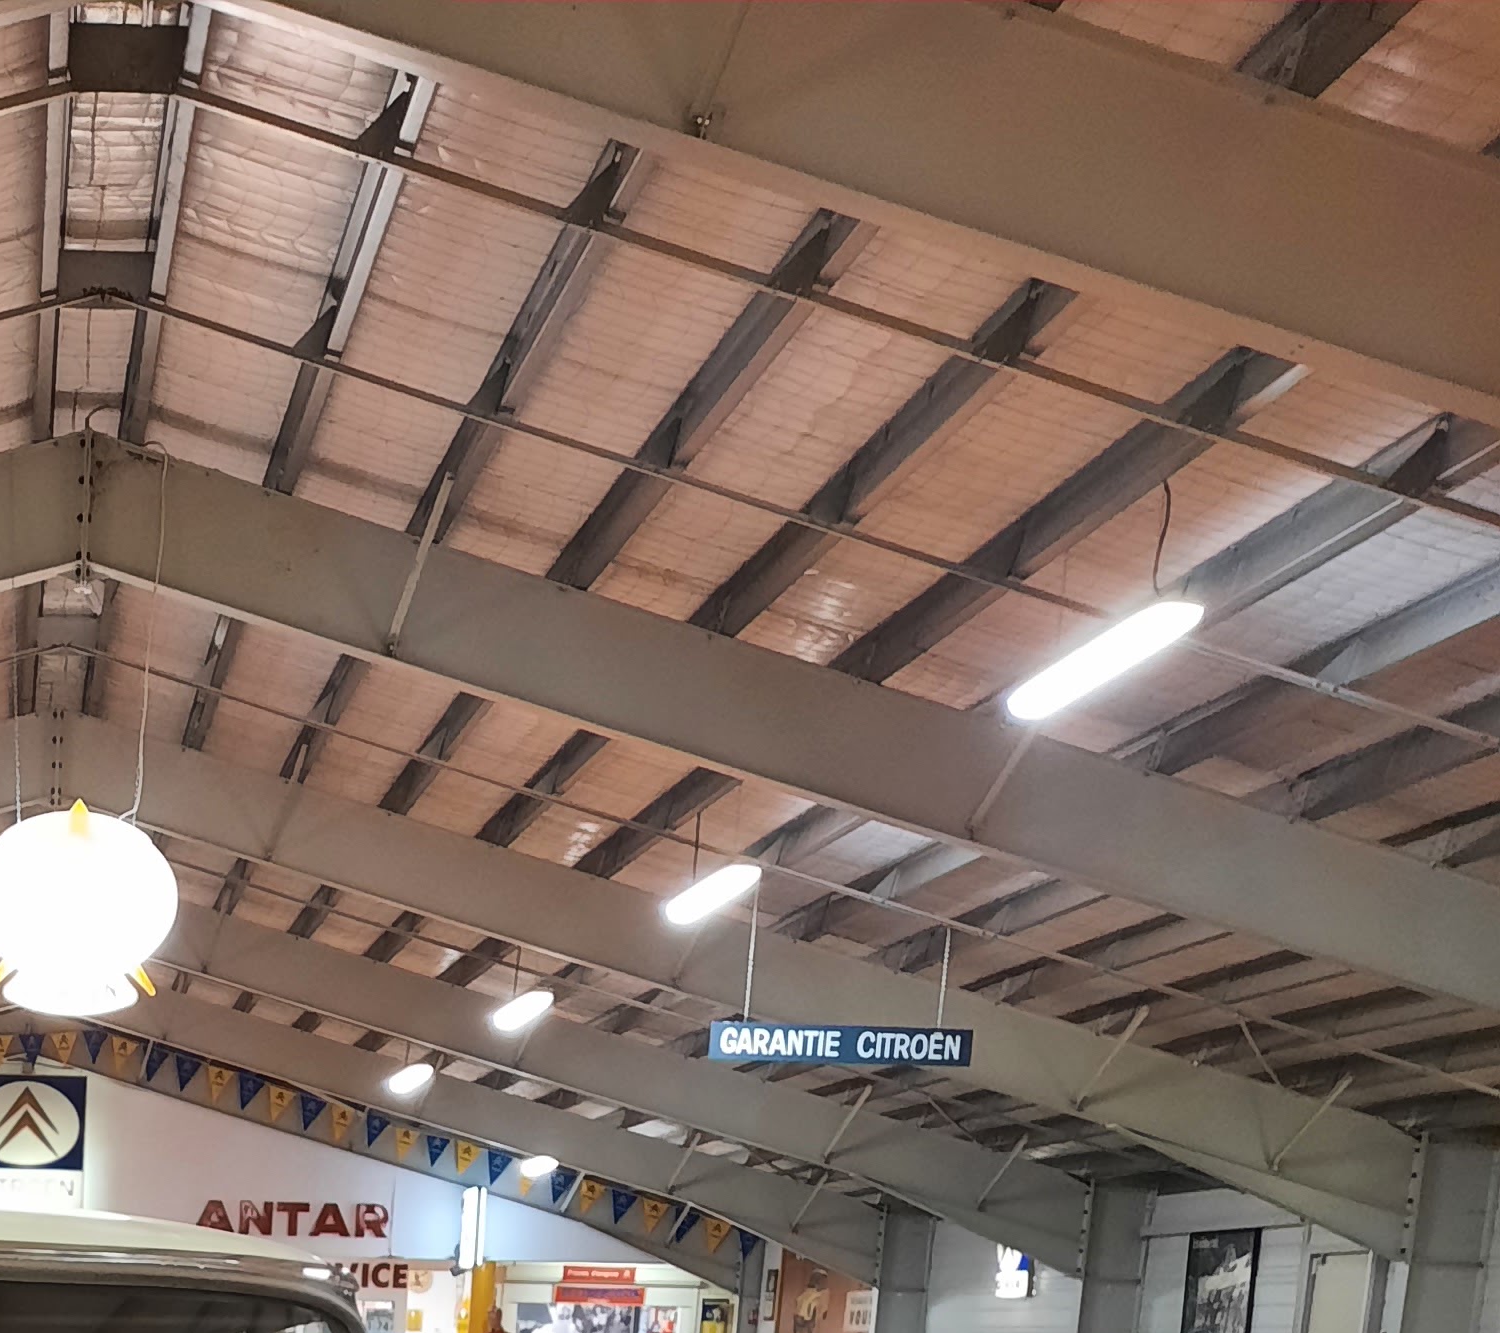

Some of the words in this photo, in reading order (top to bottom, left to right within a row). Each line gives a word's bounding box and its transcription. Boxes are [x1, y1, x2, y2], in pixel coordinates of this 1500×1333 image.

[719, 1027, 841, 1057] GARANTIE
[856, 1031, 962, 1060] CITROËN
[196, 1199, 389, 1239] ANTAR
